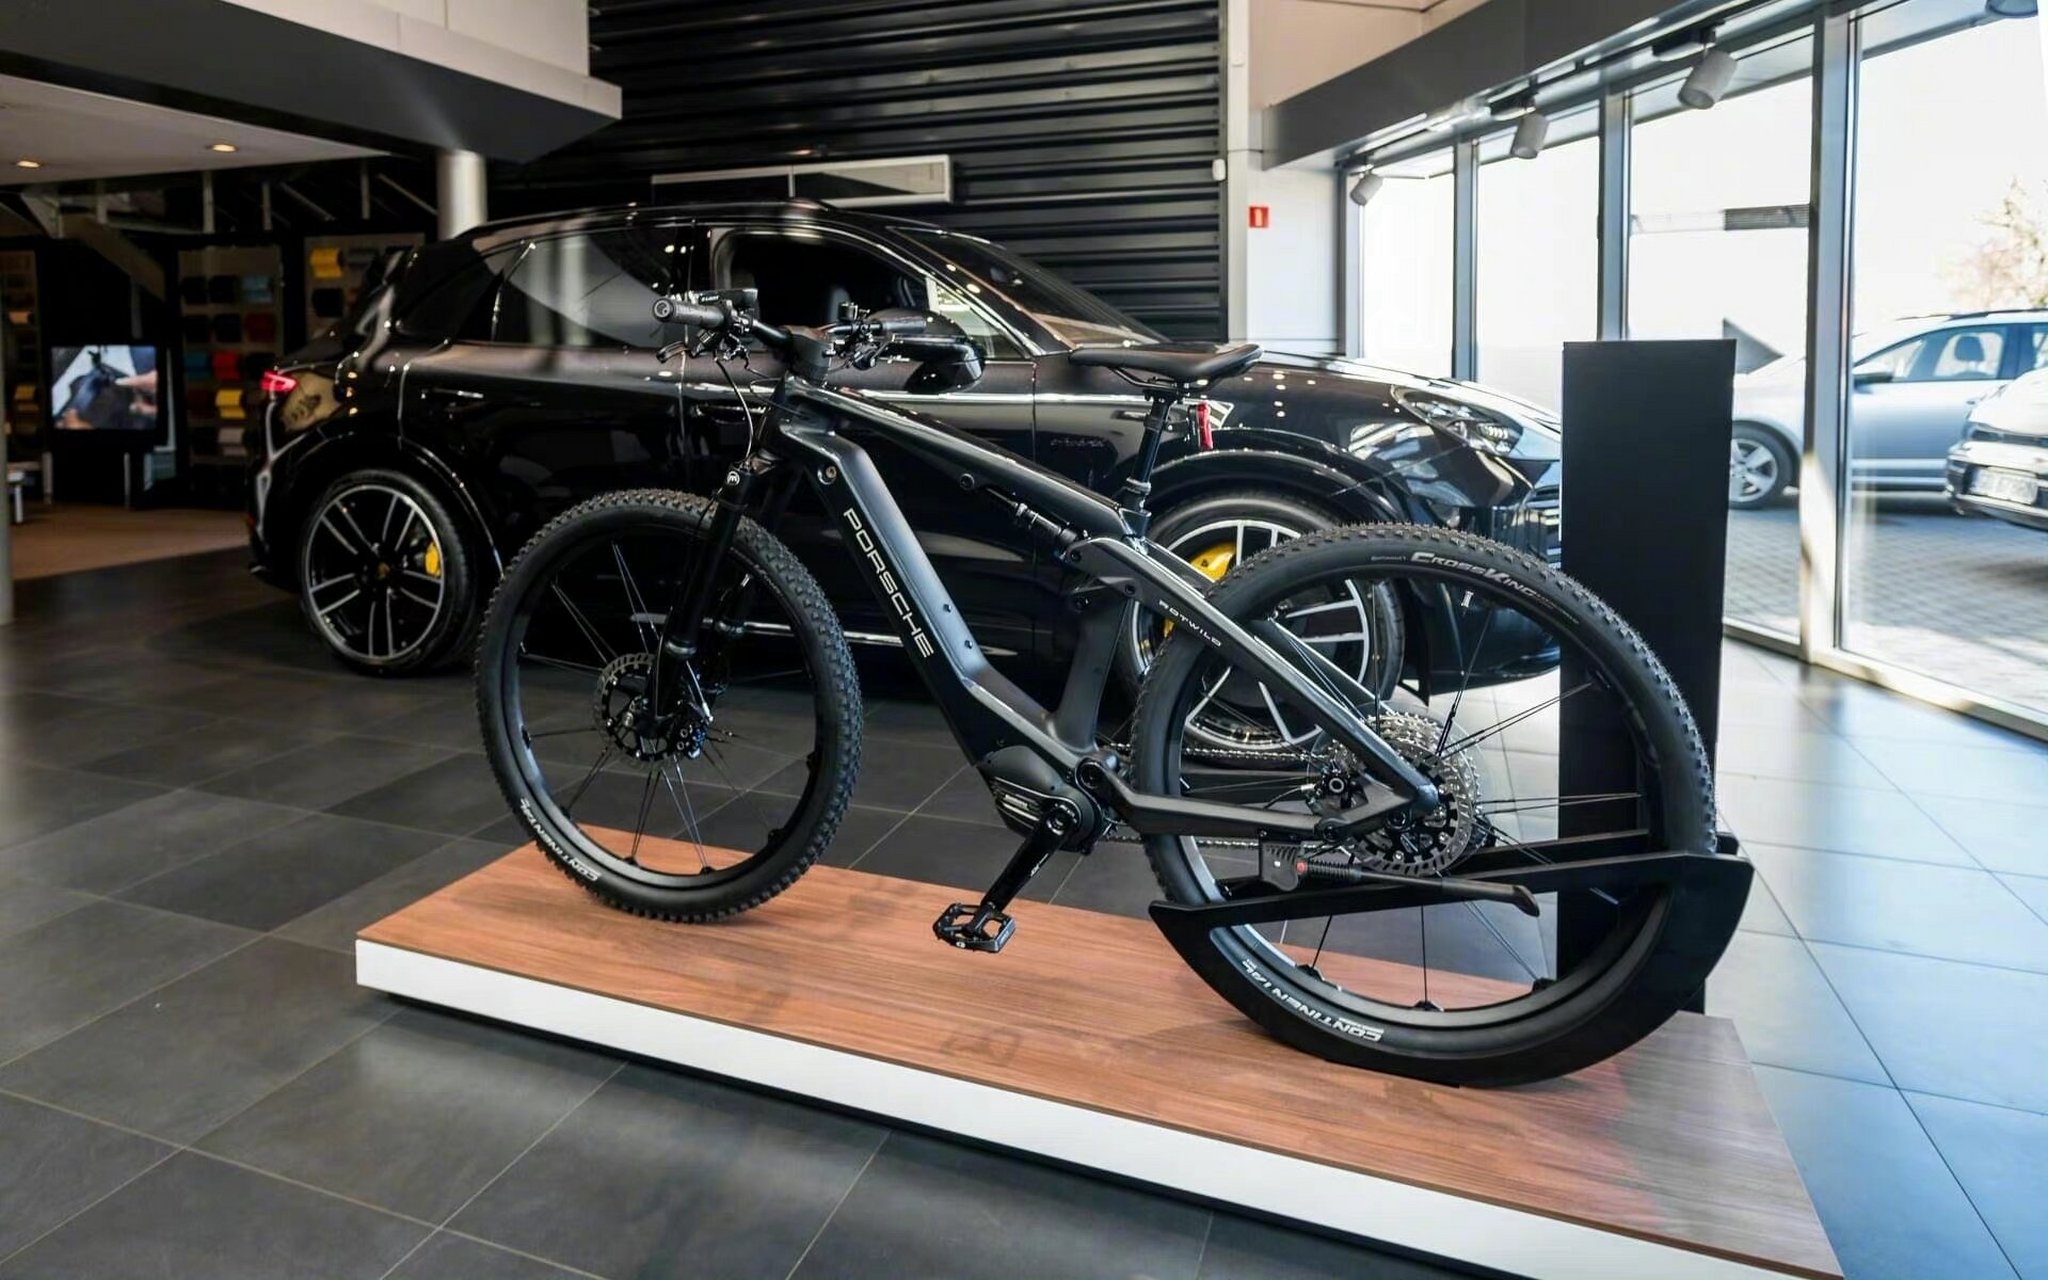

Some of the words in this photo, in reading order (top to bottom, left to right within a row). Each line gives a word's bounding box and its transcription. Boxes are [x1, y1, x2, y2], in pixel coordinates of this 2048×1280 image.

[843, 508, 934, 658] PORSCHE
[1158, 599, 1222, 647] ROTWILD
[1242, 958, 1385, 1042] CONTINENTAL
